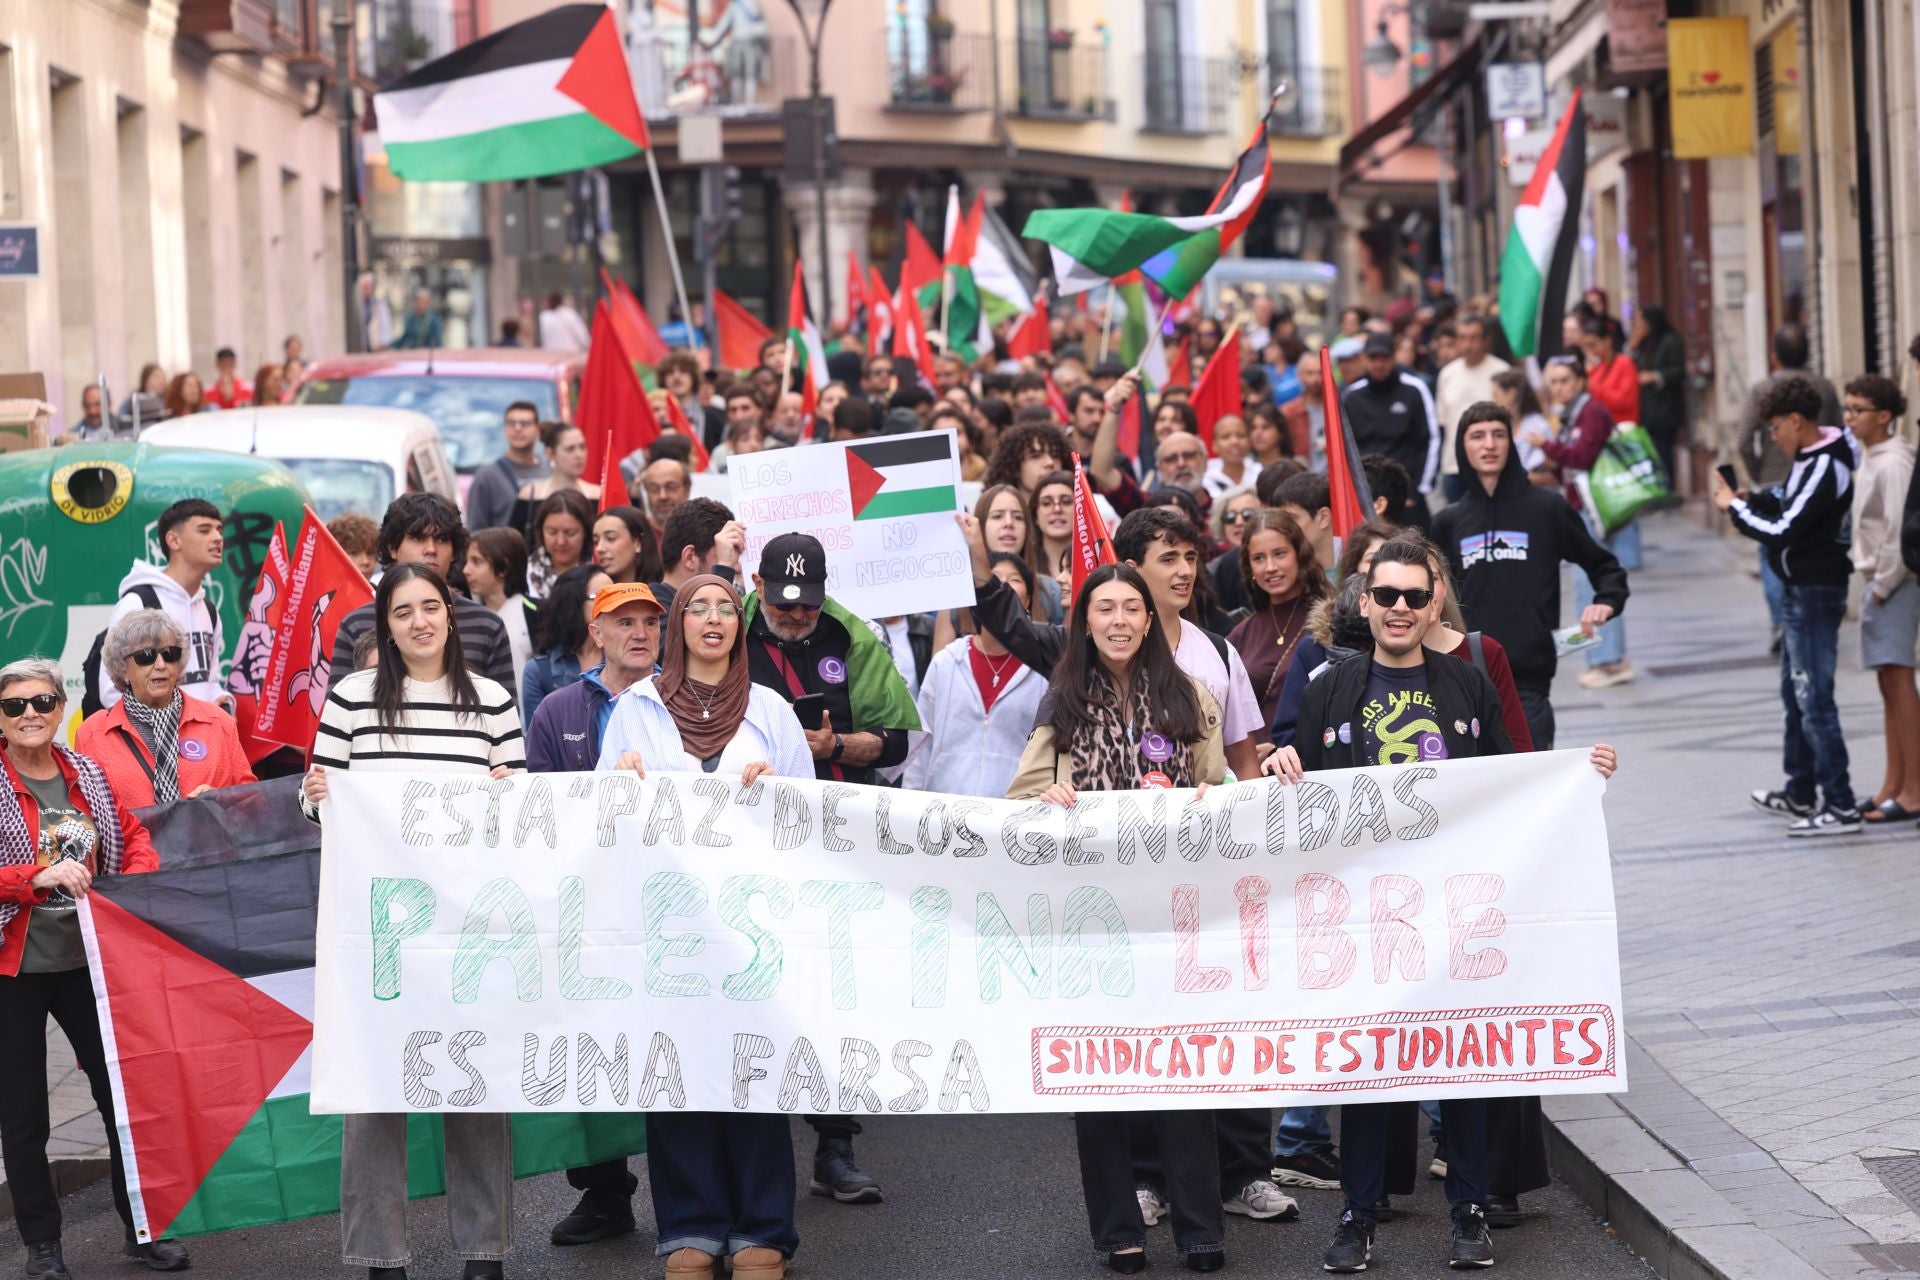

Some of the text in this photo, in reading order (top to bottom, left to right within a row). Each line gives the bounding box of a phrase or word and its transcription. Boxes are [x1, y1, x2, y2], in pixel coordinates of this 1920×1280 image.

[739, 460, 792, 490] LOS
[61, 496, 124, 521] DE VIDRIO
[738, 489, 848, 525] DERECHOS
[881, 521, 918, 550] NO
[856, 550, 968, 588] NEGOCIO
[1082, 545, 1095, 571] de
[257, 525, 318, 733] Sindicato de Estudiantes
[1362, 699, 1384, 728] LOS
[1388, 690, 1437, 711] ANGE
[401, 776, 558, 850] ESTA
[772, 783, 861, 853] DE
[876, 791, 994, 858] LOS
[1001, 767, 1440, 866] GENOCIDAS
[1046, 1017, 1603, 1079] SINDICATO DE ESTUDIANTES
[403, 1030, 991, 1113] ES UNA FARSA
